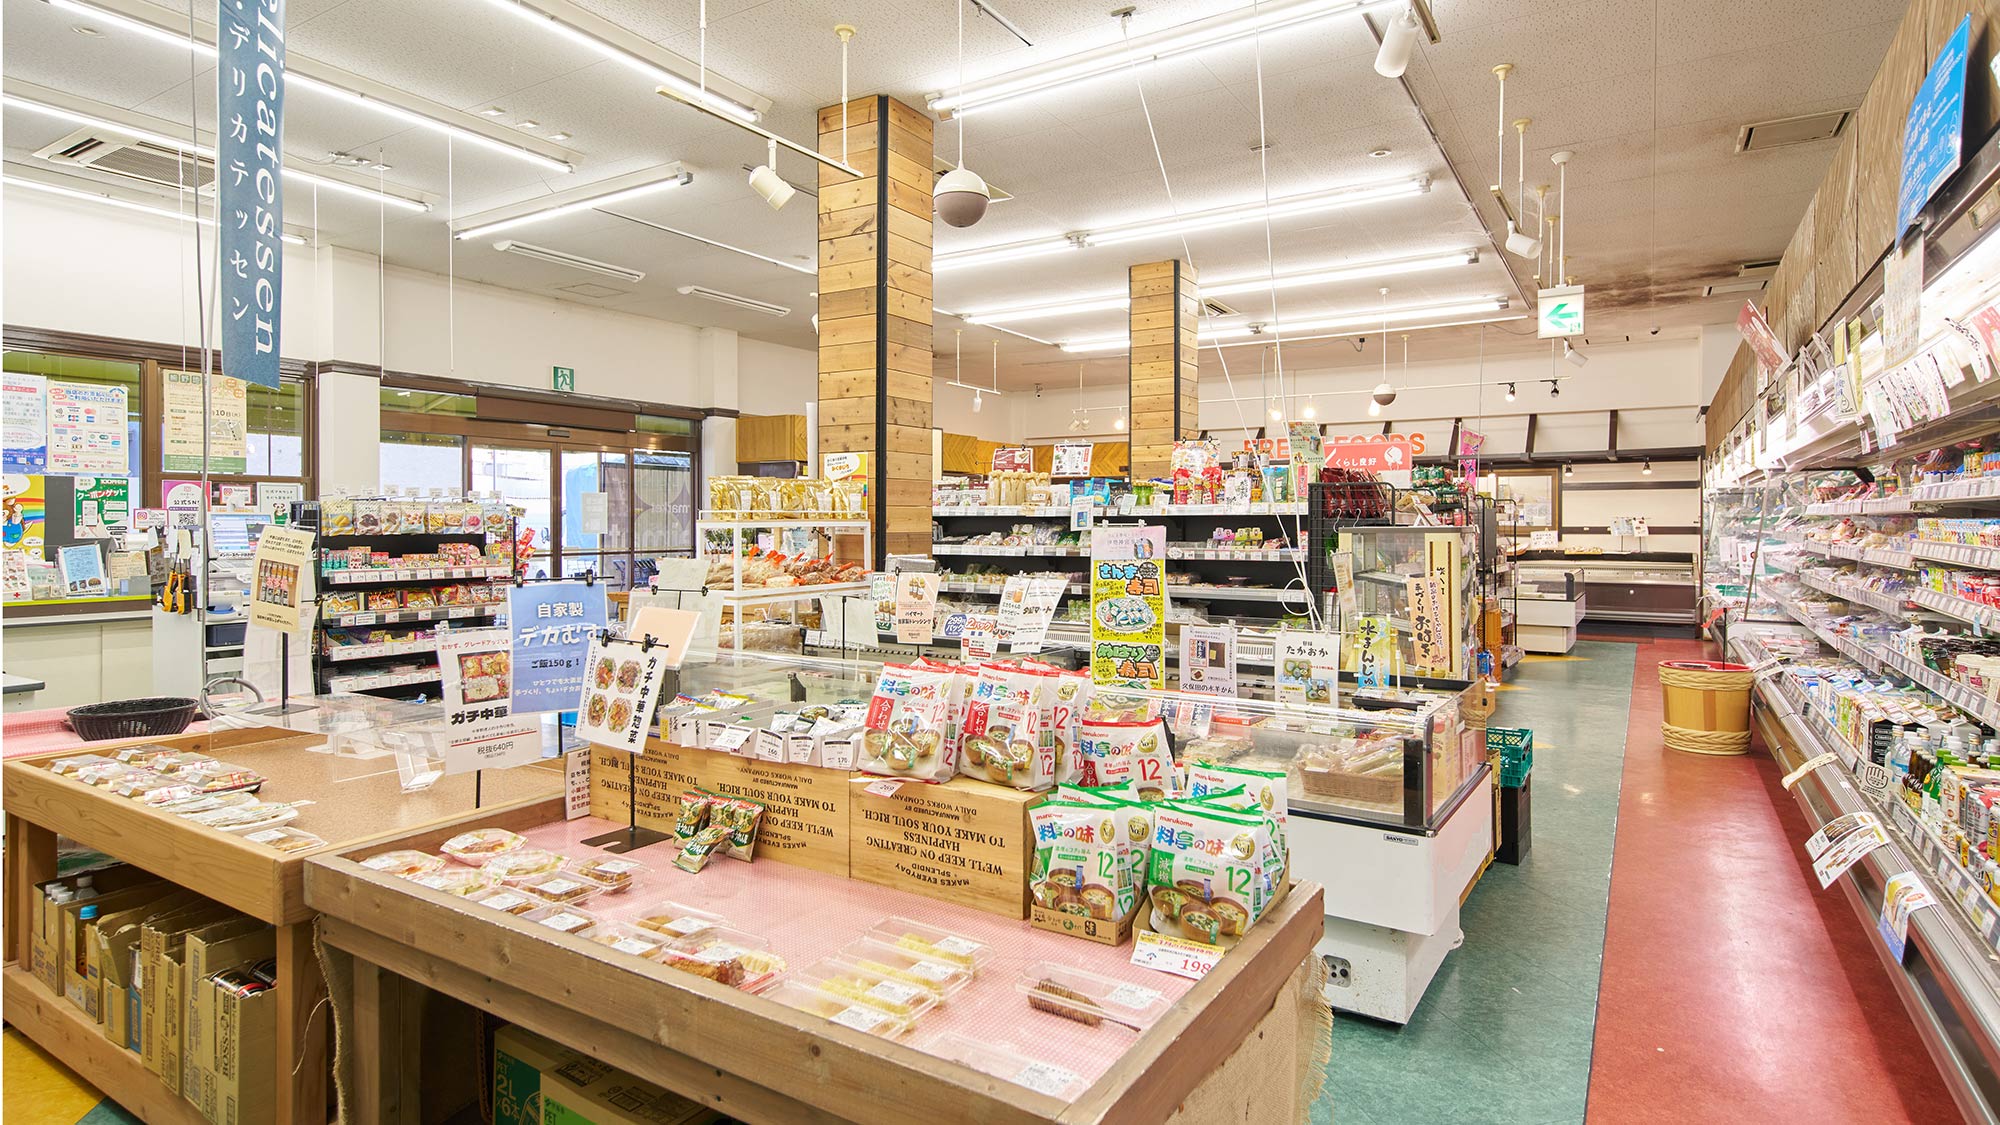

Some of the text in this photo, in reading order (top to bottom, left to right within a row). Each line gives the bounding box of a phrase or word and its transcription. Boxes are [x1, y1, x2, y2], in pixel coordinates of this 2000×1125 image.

[1335, 456, 1377, 467] くらし良好
[77, 487, 127, 501] クーポンゲット
[1099, 564, 1138, 580] さんま
[1126, 577, 1160, 596] 寿司
[537, 602, 584, 618] 自家製
[1415, 615, 1436, 659] おはぎ
[1286, 645, 1329, 657] たかおか
[1116, 660, 1159, 680] 寿司
[451, 705, 508, 726] ガチ中華
[876, 700, 892, 729] 合わせ
[973, 702, 990, 735] 合わせ
[1026, 711, 1037, 735] 12
[1053, 706, 1070, 730] 12
[477, 742, 514, 755] 税抜640円
[643, 765, 663, 777] YOUR
[663, 769, 686, 783] MAKE
[771, 772, 793, 782] WORKS
[1138, 758, 1162, 781] 12
[687, 776, 699, 786] TO
[793, 776, 813, 785] DAILY
[639, 789, 651, 798] ON
[716, 782, 836, 812] TO MAKE YOUR SOUL RICH.
[913, 807, 960, 820] MANUFACTURED
[926, 800, 954, 811] WORKS
[955, 806, 977, 815] DAILY
[765, 816, 834, 837] WE'LL KEEP ON
[862, 809, 1005, 848] TO MAKE YOUR SOUL RICH.
[1160, 815, 1194, 828] marukome
[903, 831, 960, 851] HAPPINESS
[1156, 825, 1225, 857] 料亭の味
[866, 836, 1003, 875] WE'LL KEEP ON CREATING
[895, 863, 938, 885] EVERYDAY
[912, 863, 951, 877] SPLENDID
[1097, 851, 1114, 879] 12
[1225, 866, 1251, 896] 12
[1181, 958, 1211, 975] 198
